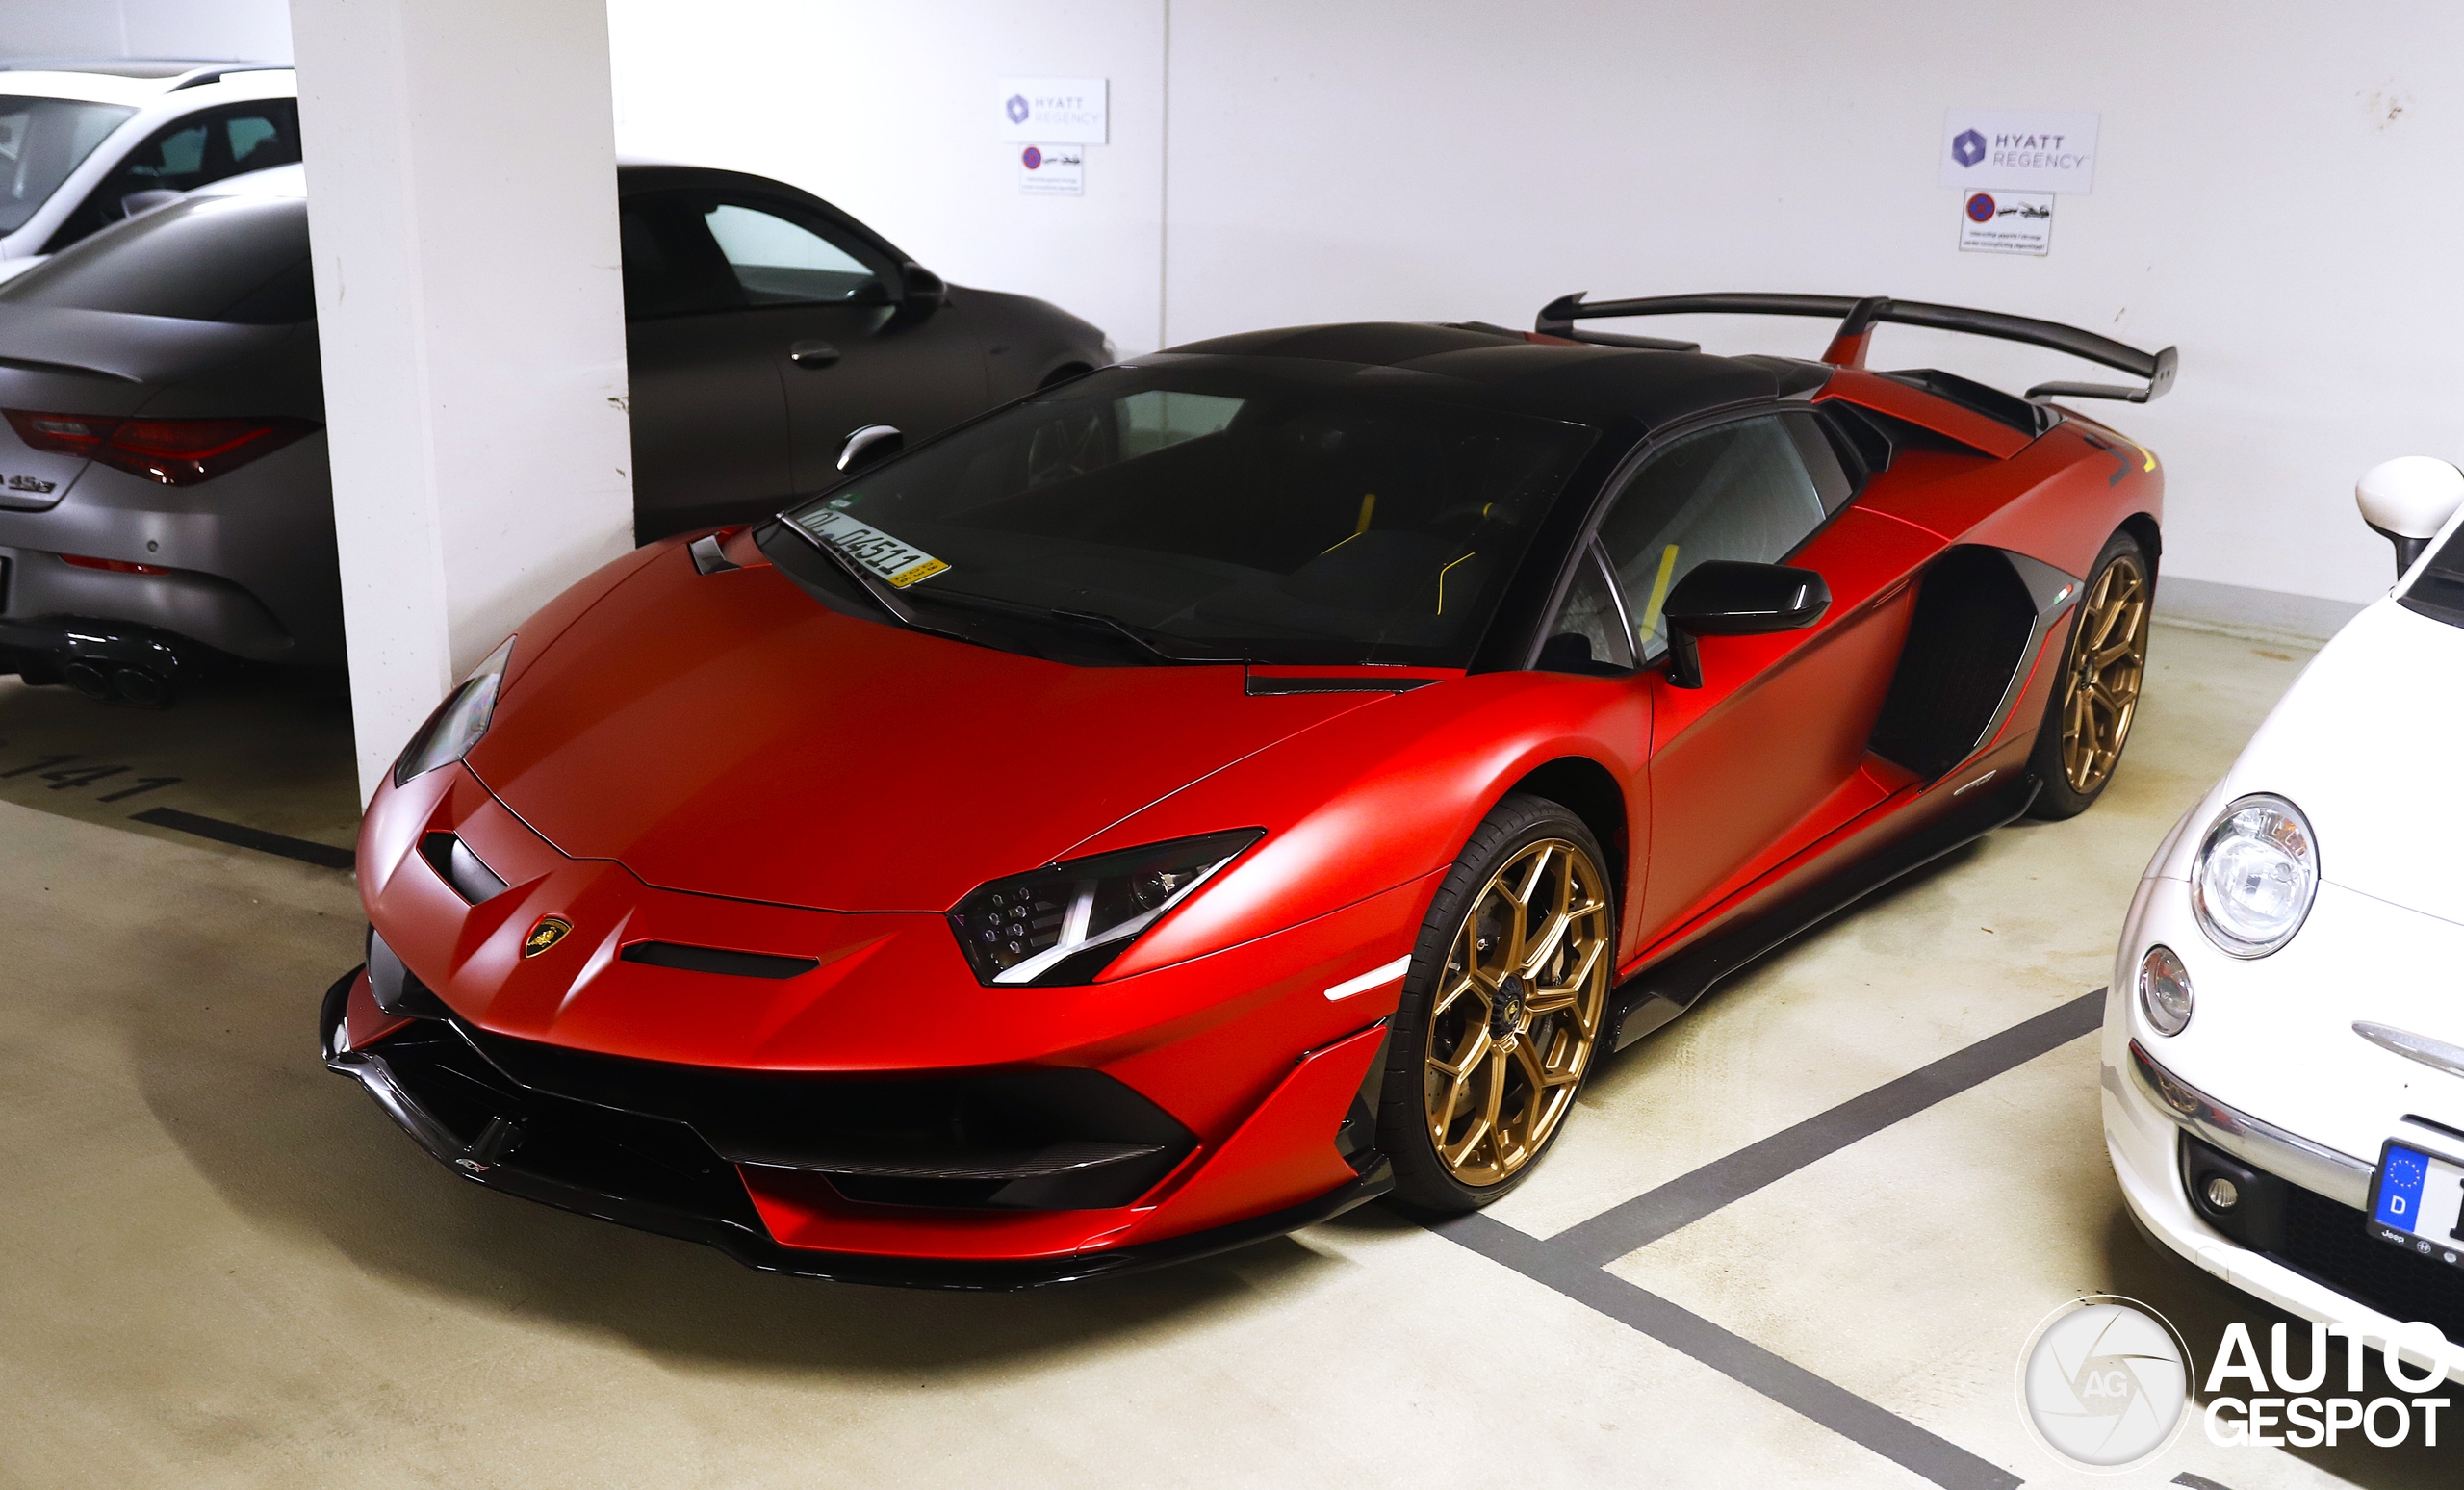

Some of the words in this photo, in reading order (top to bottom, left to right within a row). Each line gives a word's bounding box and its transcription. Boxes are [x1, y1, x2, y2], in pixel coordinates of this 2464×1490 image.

[1035, 96, 1084, 109] HYATT
[1035, 111, 1100, 125] REGENCY
[1995, 134, 2065, 149] HYATT
[1992, 151, 2085, 169] REGENCY
[2390, 1195, 2406, 1215] D
[2381, 1230, 2405, 1245] Jeep
